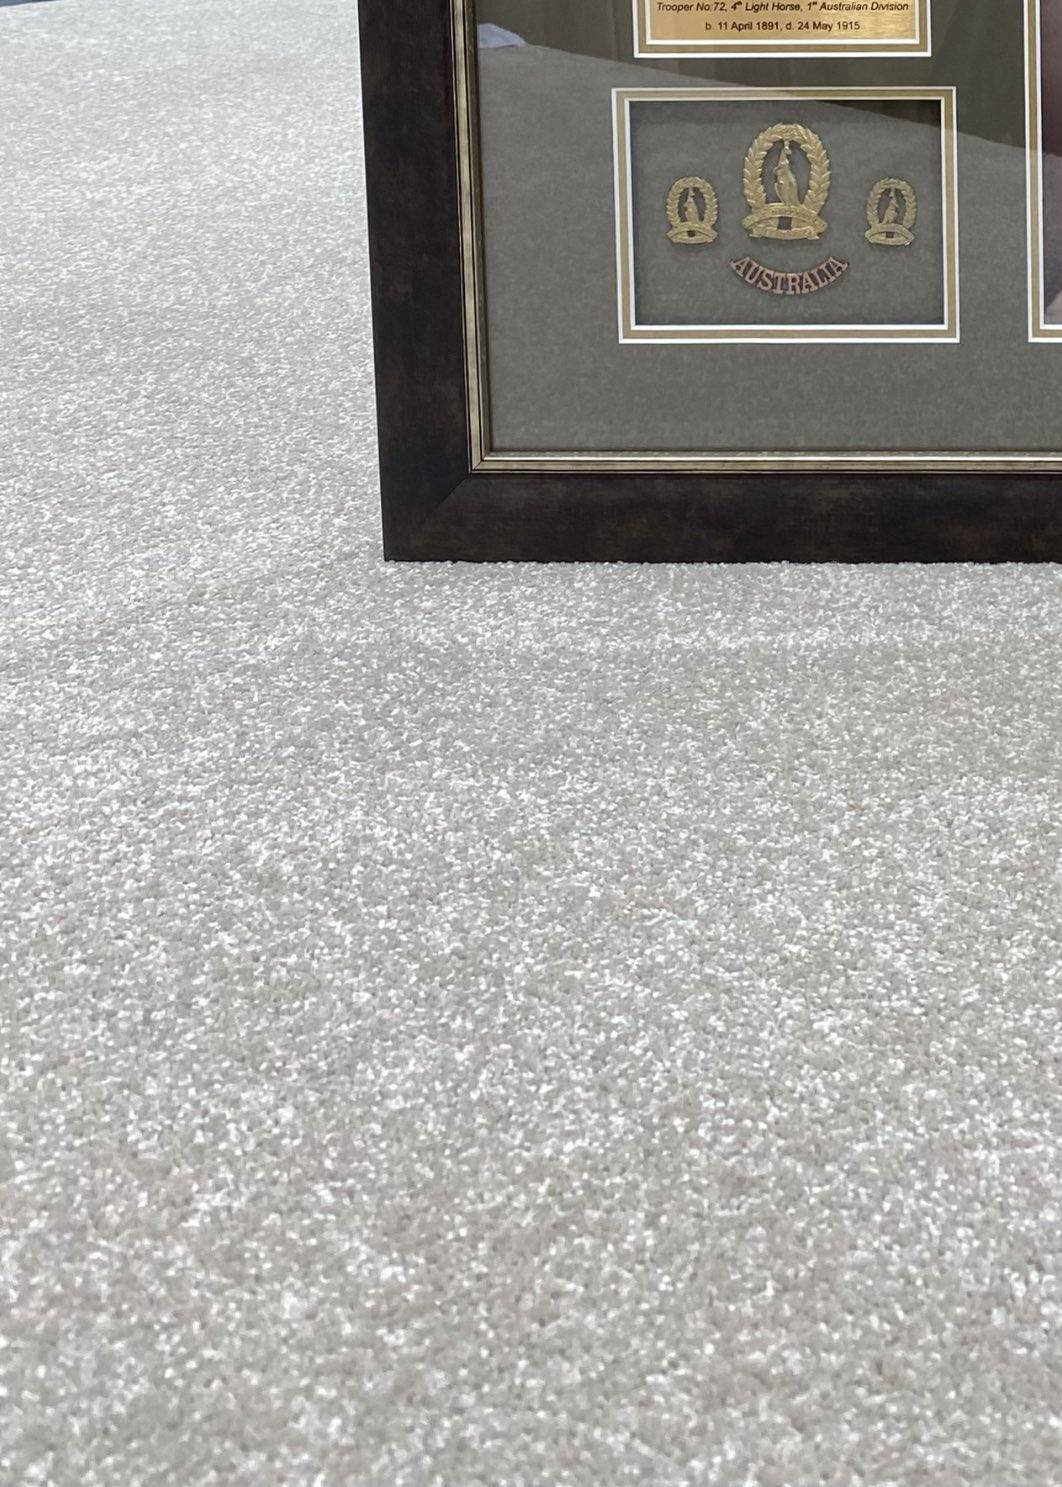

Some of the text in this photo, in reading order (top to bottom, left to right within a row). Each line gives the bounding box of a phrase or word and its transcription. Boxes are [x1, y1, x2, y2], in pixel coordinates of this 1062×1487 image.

[657, 1, 694, 13] Trooper
[745, 1, 769, 13] Light
[772, 1, 803, 12] Horse,
[819, 1, 868, 11] Australian
[870, 1, 909, 11] Division
[718, 21, 728, 30] 11
[731, 21, 753, 32] April
[756, 21, 783, 32] 1891,
[798, 21, 810, 30] 24
[812, 21, 833, 32] May
[729, 255, 849, 295] AUSTRALIA
